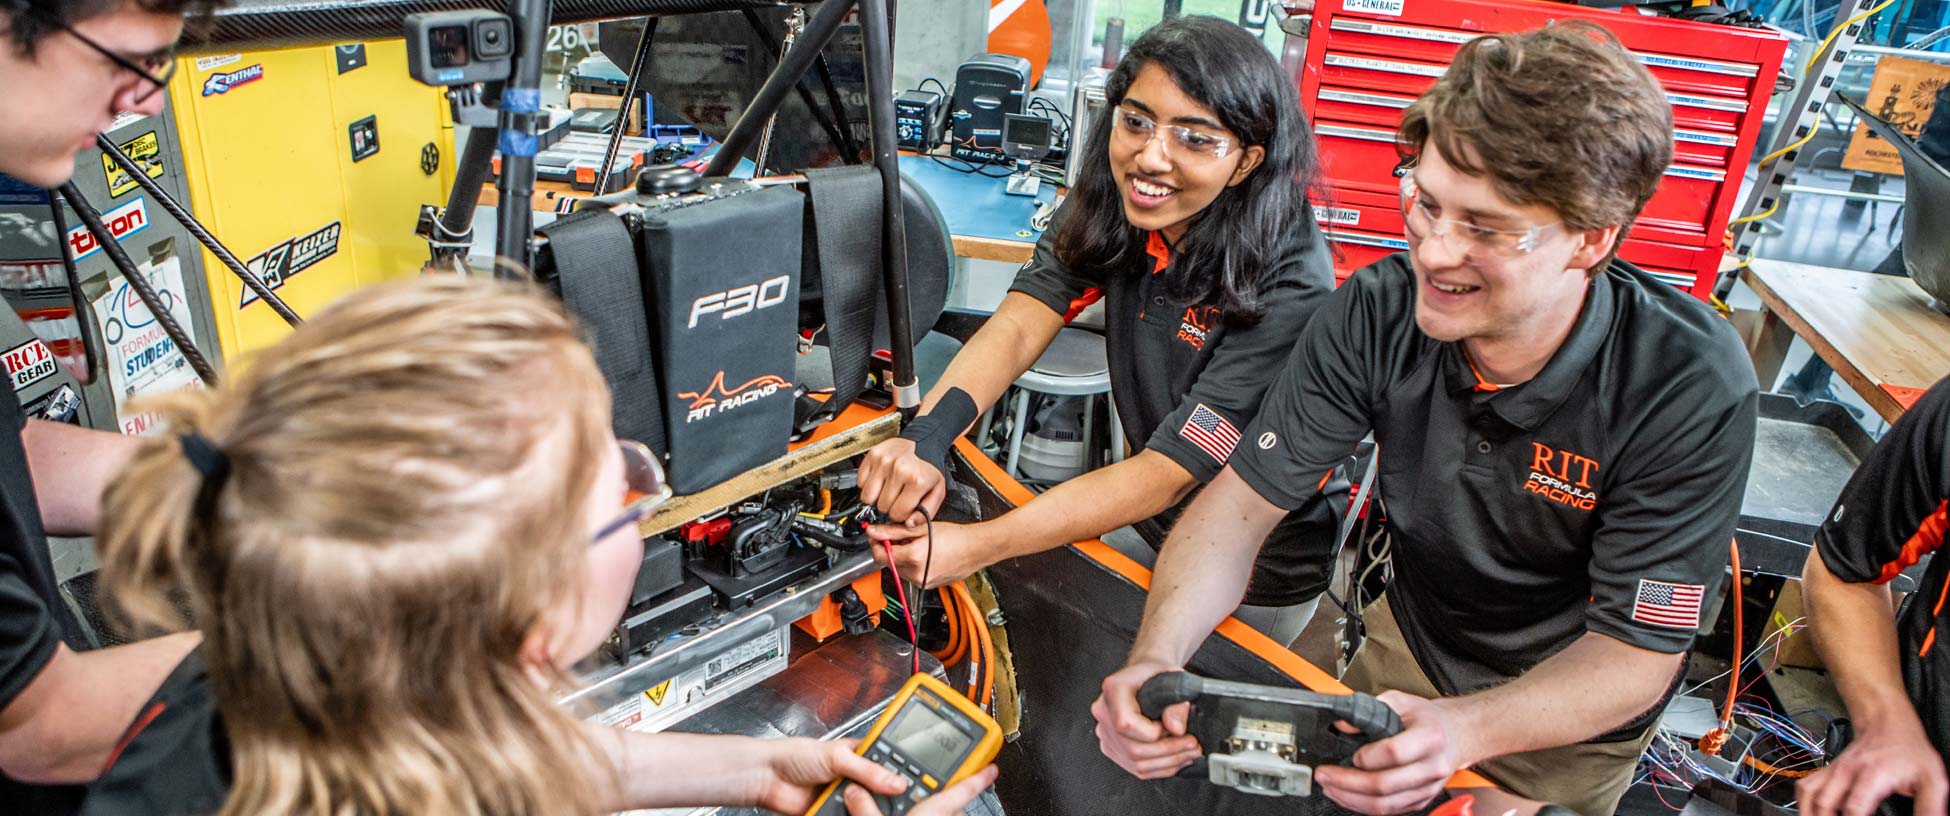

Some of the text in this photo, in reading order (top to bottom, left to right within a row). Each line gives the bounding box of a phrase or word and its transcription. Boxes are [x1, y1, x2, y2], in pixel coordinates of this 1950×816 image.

[292, 224, 339, 260] KEIZER
[688, 275, 790, 329] F30
[5, 342, 49, 375] RCE
[17, 360, 53, 385] GEAR
[687, 383, 779, 423] RIT RACING
[1529, 441, 1600, 489] RIT
[1523, 480, 1597, 511] RACING
[1529, 471, 1597, 501] FORMULA
